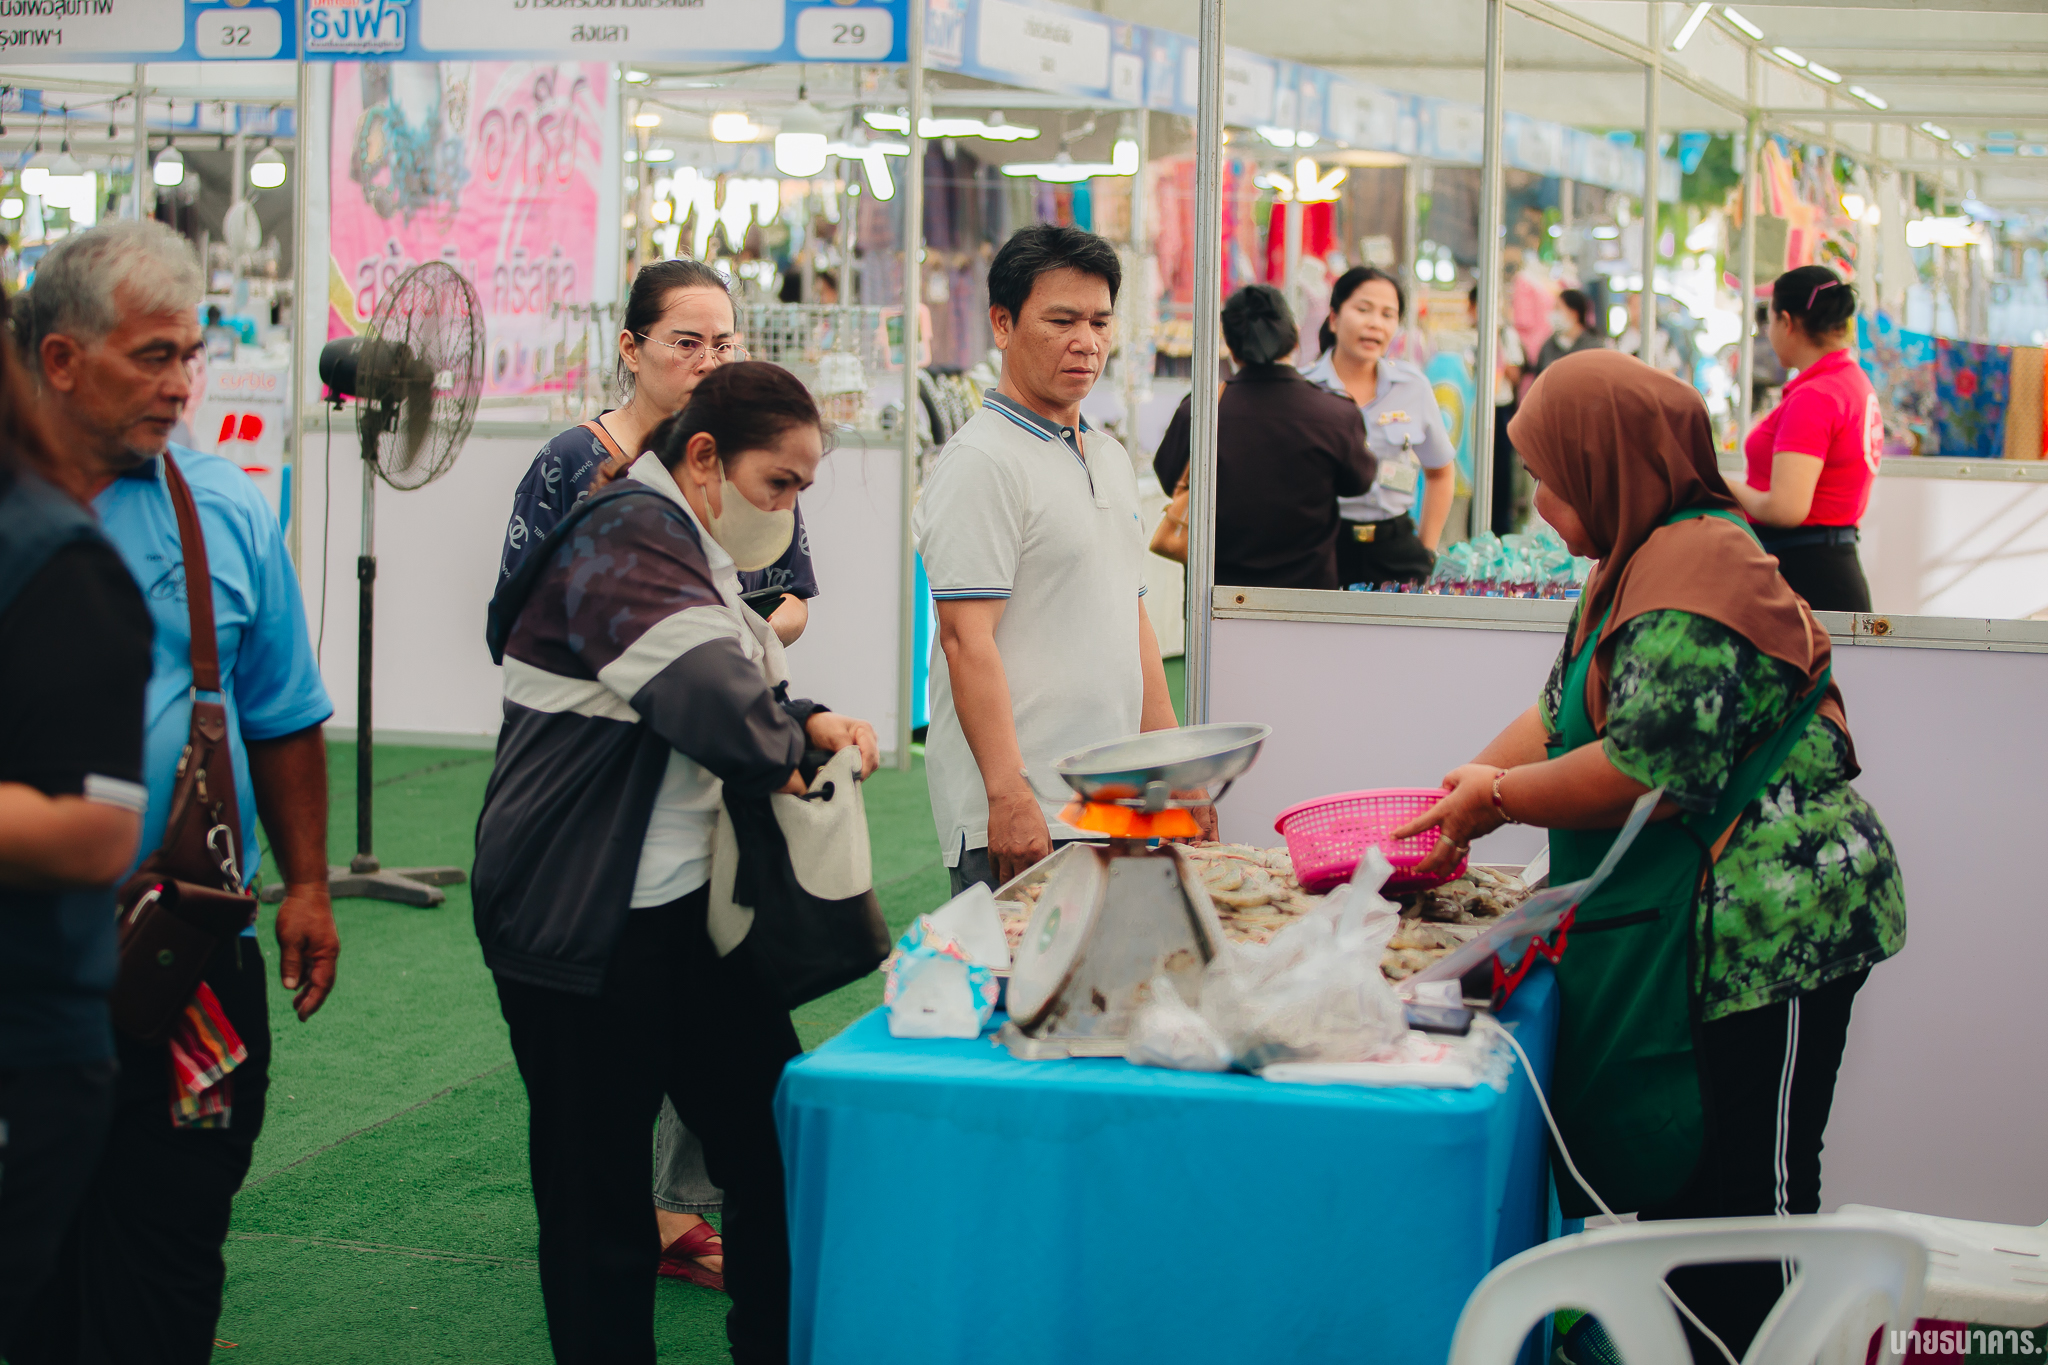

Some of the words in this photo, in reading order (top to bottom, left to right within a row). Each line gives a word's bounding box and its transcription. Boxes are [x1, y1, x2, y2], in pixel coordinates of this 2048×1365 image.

[0, 29, 62, 51] รุงเทพฯ
[221, 26, 252, 46] 32
[571, 23, 629, 42] สงขลา
[832, 24, 866, 44] 29
[569, 460, 594, 484] CHANEL
